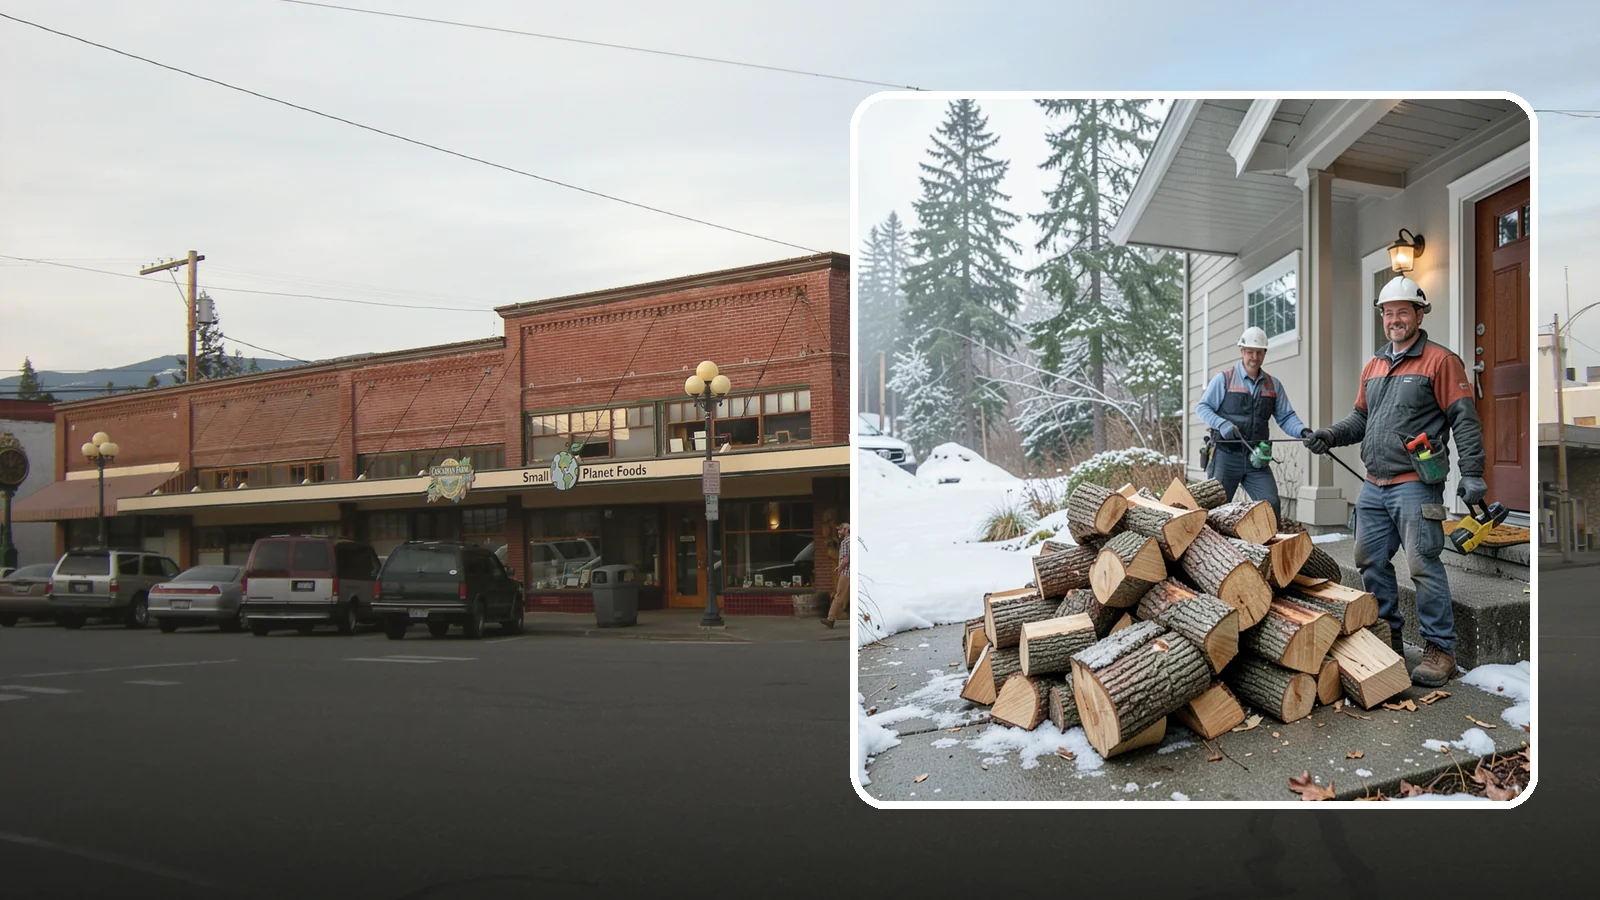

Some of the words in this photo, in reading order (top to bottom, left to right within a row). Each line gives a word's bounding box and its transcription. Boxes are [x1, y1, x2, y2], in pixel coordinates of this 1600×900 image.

[523, 471, 549, 483] Small
[583, 467, 614, 479] Planet
[617, 464, 647, 477] Foods
